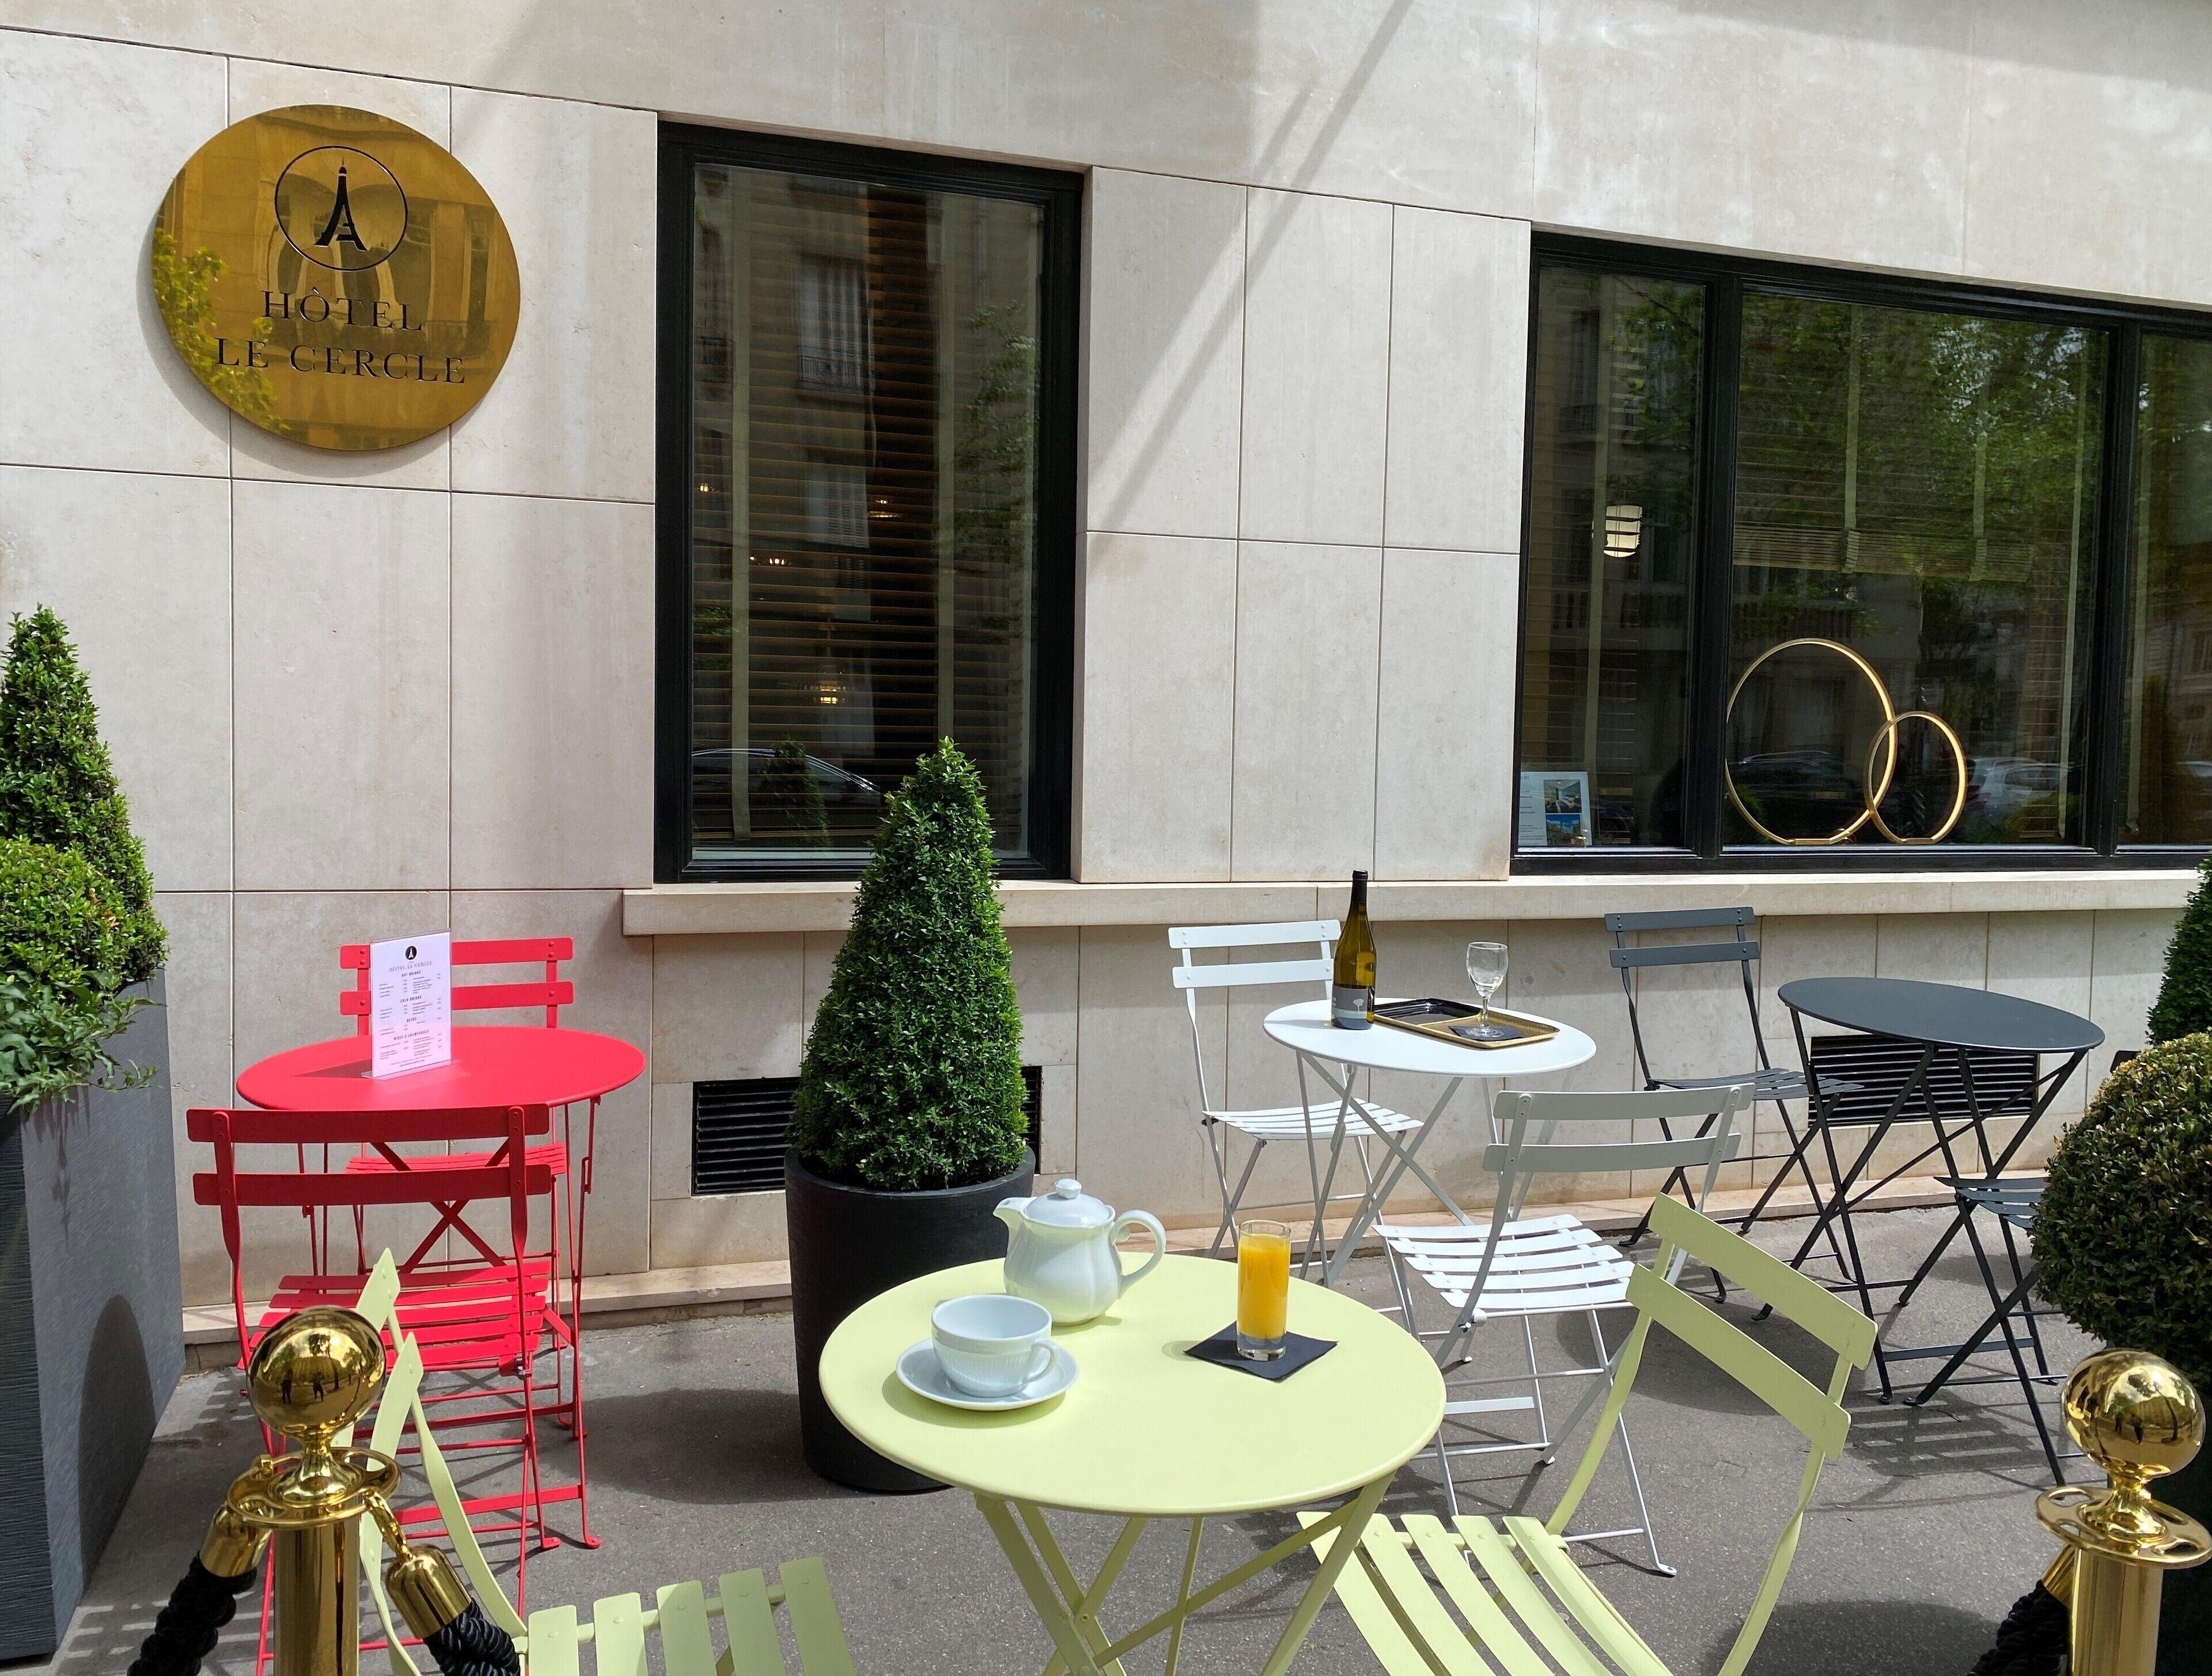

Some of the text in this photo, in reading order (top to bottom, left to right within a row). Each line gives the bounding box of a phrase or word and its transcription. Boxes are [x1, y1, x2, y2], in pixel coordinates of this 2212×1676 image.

[261, 287, 422, 331] HÔTEL
[214, 338, 465, 384] LE CERCLE
